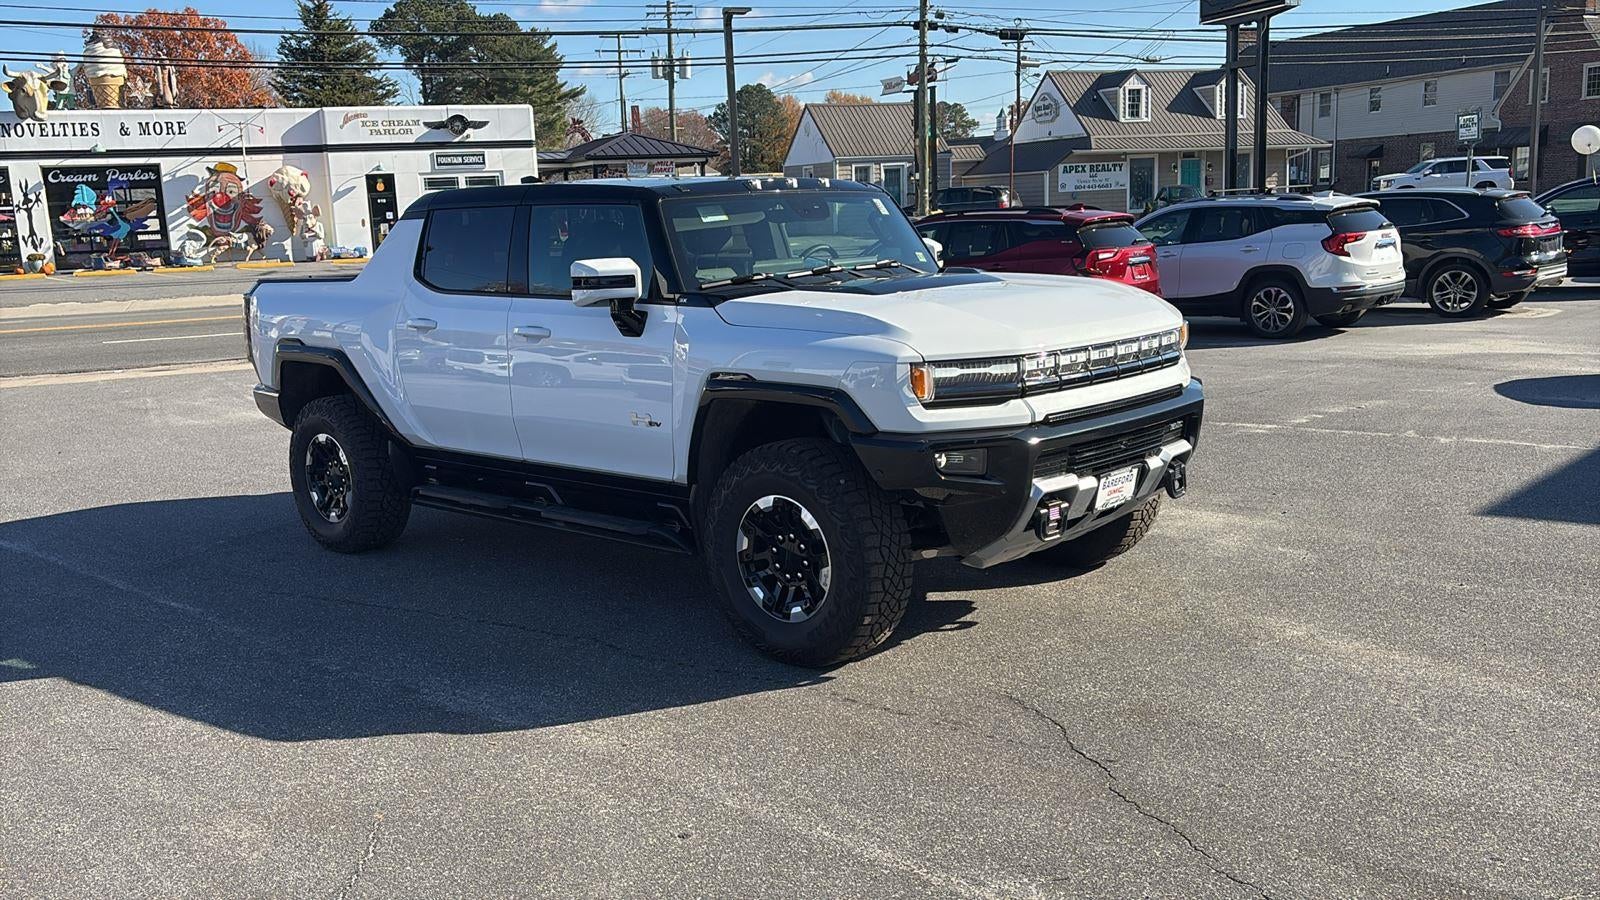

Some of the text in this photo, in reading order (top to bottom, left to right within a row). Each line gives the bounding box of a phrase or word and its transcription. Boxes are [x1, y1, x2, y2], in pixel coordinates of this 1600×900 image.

[0, 120, 188, 138] NOVELTIES & MORE
[361, 119, 379, 128] ICE
[381, 119, 421, 128] CREAM
[369, 128, 414, 136] PARLOR
[437, 155, 485, 164] FOUNTAIN SERVICE
[1062, 163, 1124, 174] APEX REALTY
[47, 168, 158, 183] Cream Parlor
[1035, 334, 1175, 369] HUMMER
[1102, 473, 1134, 491] BAREFORD
[1107, 486, 1125, 497] GMC
